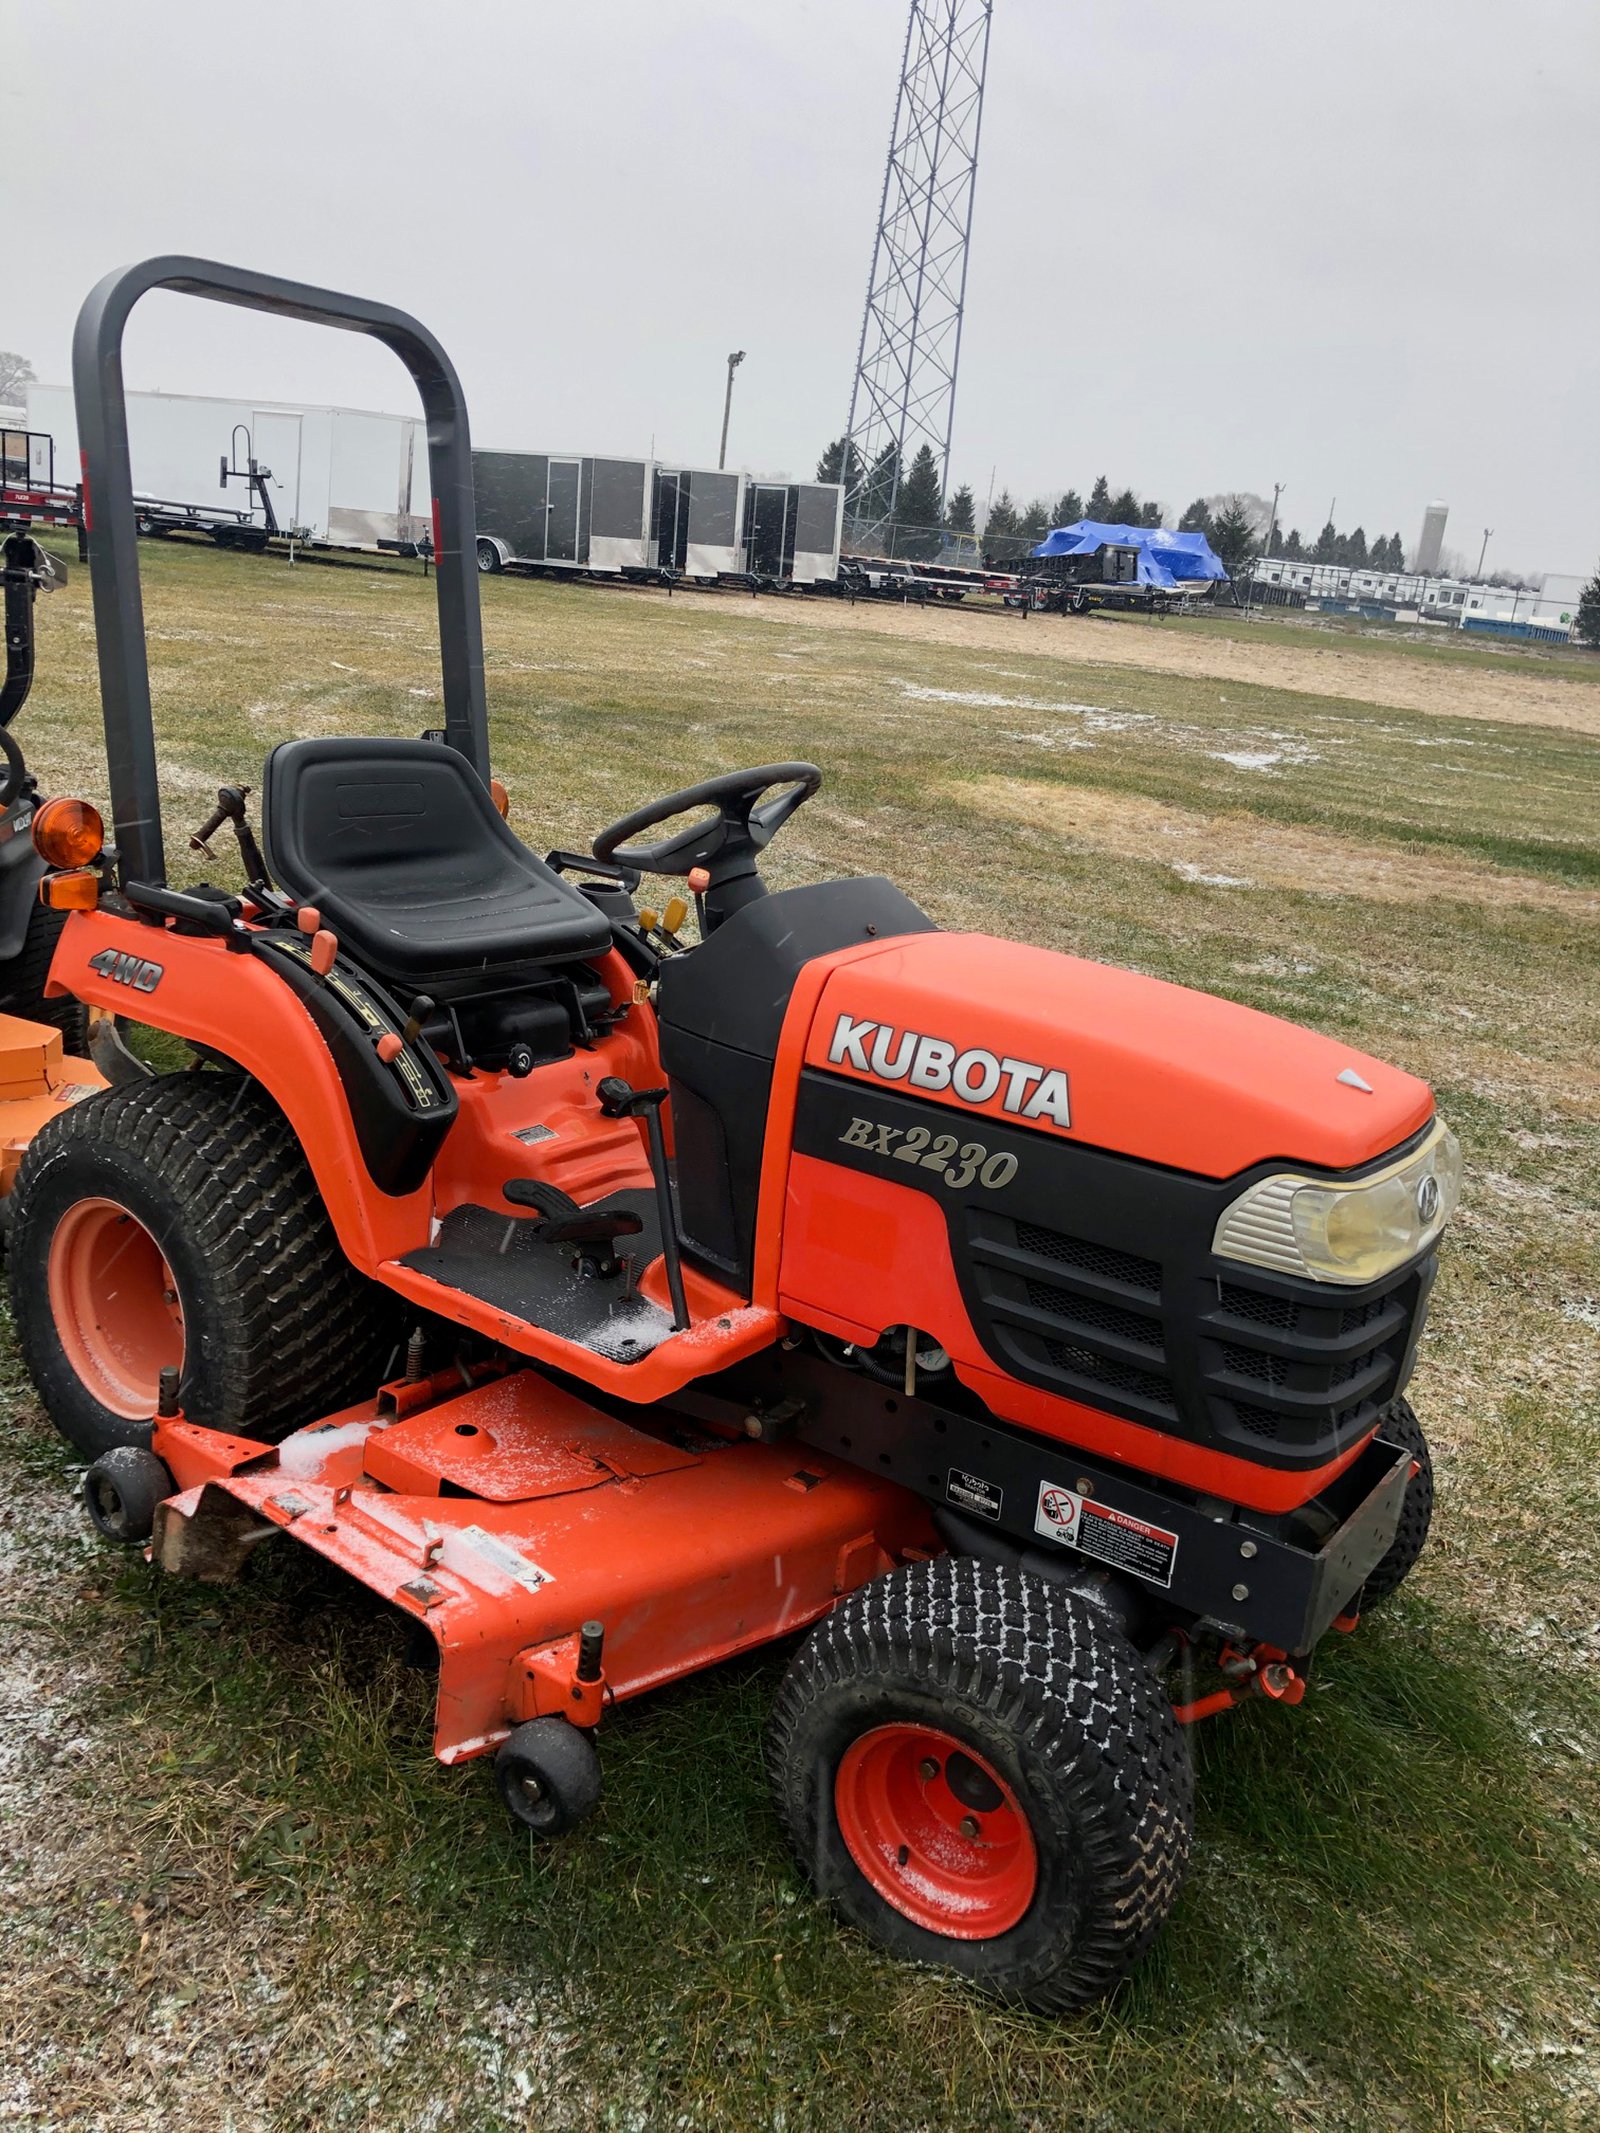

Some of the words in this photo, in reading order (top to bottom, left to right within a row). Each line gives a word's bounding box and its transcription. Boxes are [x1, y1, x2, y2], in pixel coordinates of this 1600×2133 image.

[88, 947, 164, 993] 4WD
[828, 1013, 1071, 1129] KUBOTA
[838, 1116, 1019, 1190] BX2230
[1116, 1515, 1151, 1535] DANGER
